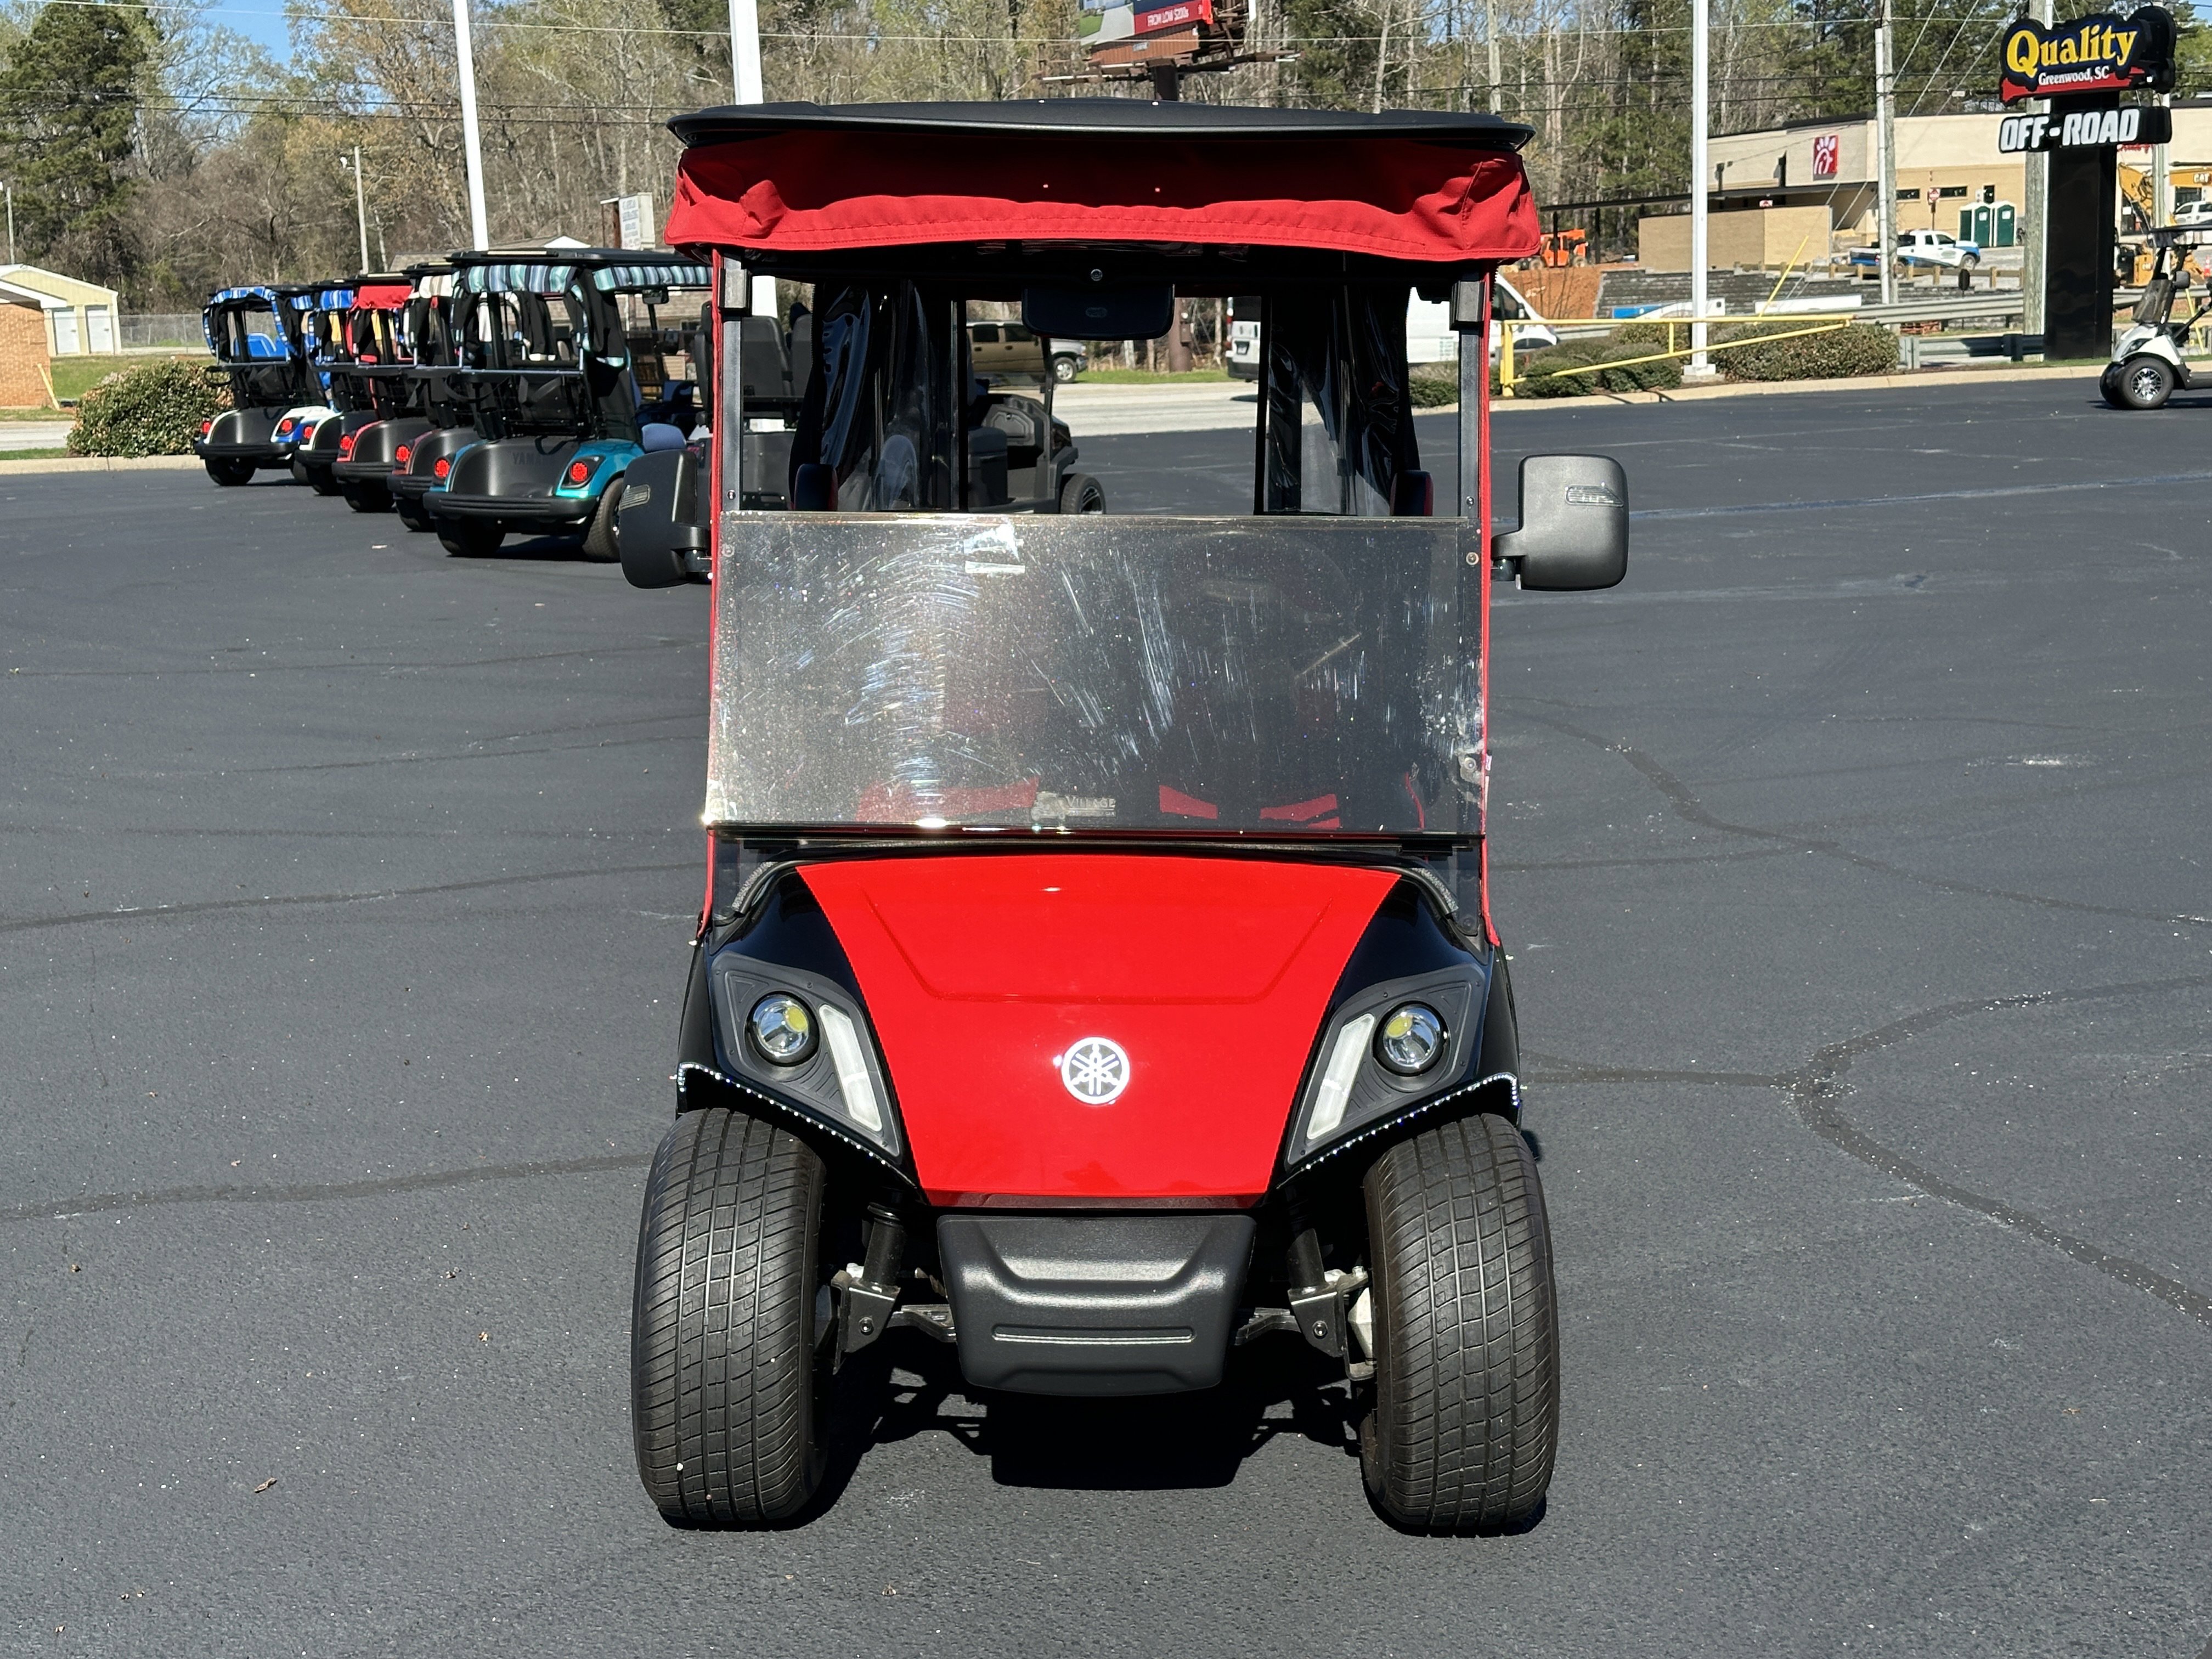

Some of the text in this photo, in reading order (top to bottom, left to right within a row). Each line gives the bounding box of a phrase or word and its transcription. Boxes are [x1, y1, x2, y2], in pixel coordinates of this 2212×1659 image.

[2006, 24, 2138, 78] Quality
[2038, 65, 2109, 85] Greenwood, SC
[1999, 109, 2140, 151] OFF-ROAD
